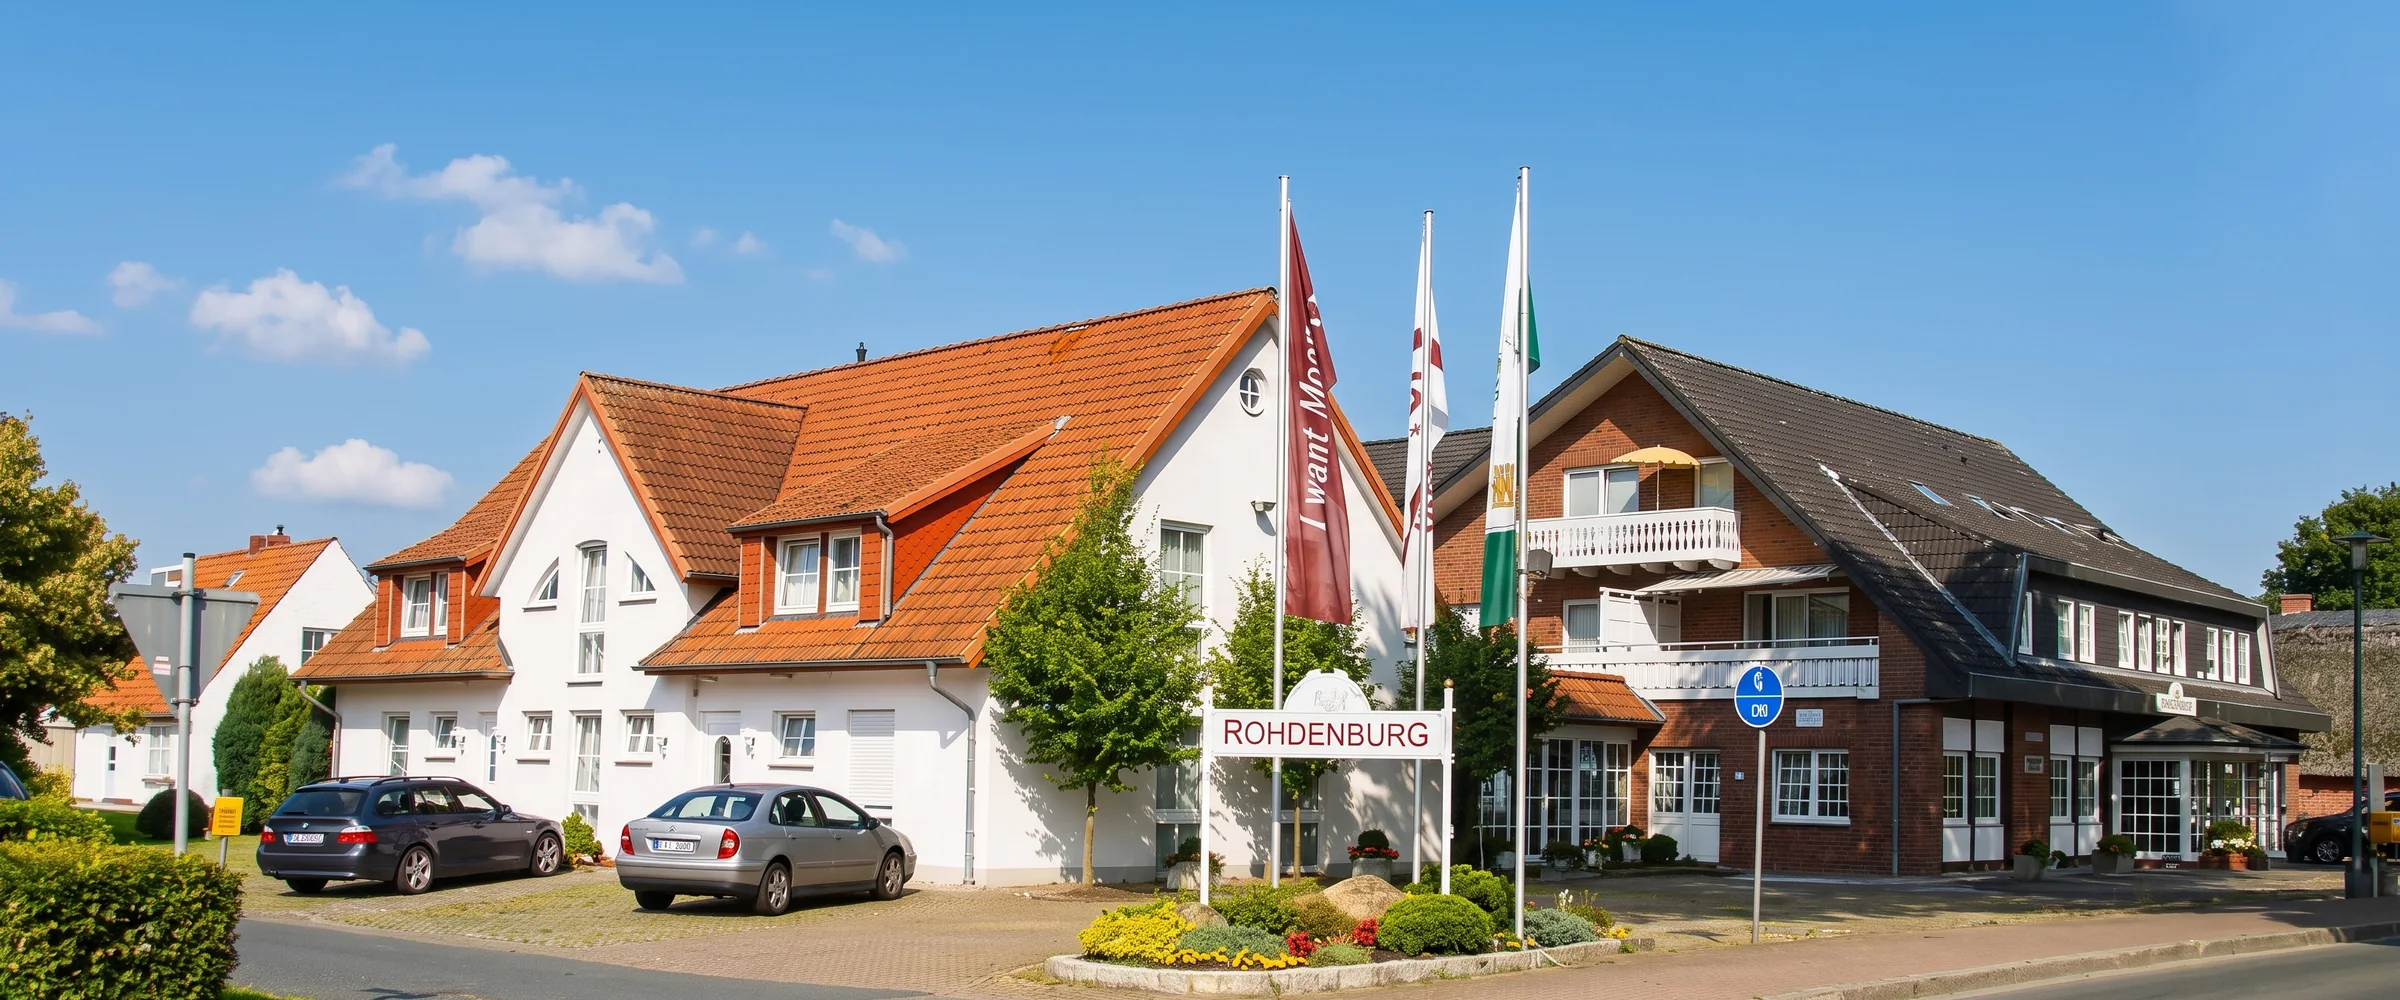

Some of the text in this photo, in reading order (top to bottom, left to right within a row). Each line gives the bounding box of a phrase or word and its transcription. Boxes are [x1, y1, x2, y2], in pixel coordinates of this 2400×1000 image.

[1303, 426, 1329, 504] want
[1299, 512, 1326, 531] I
[1224, 719, 1428, 747] ROHDENBURG
